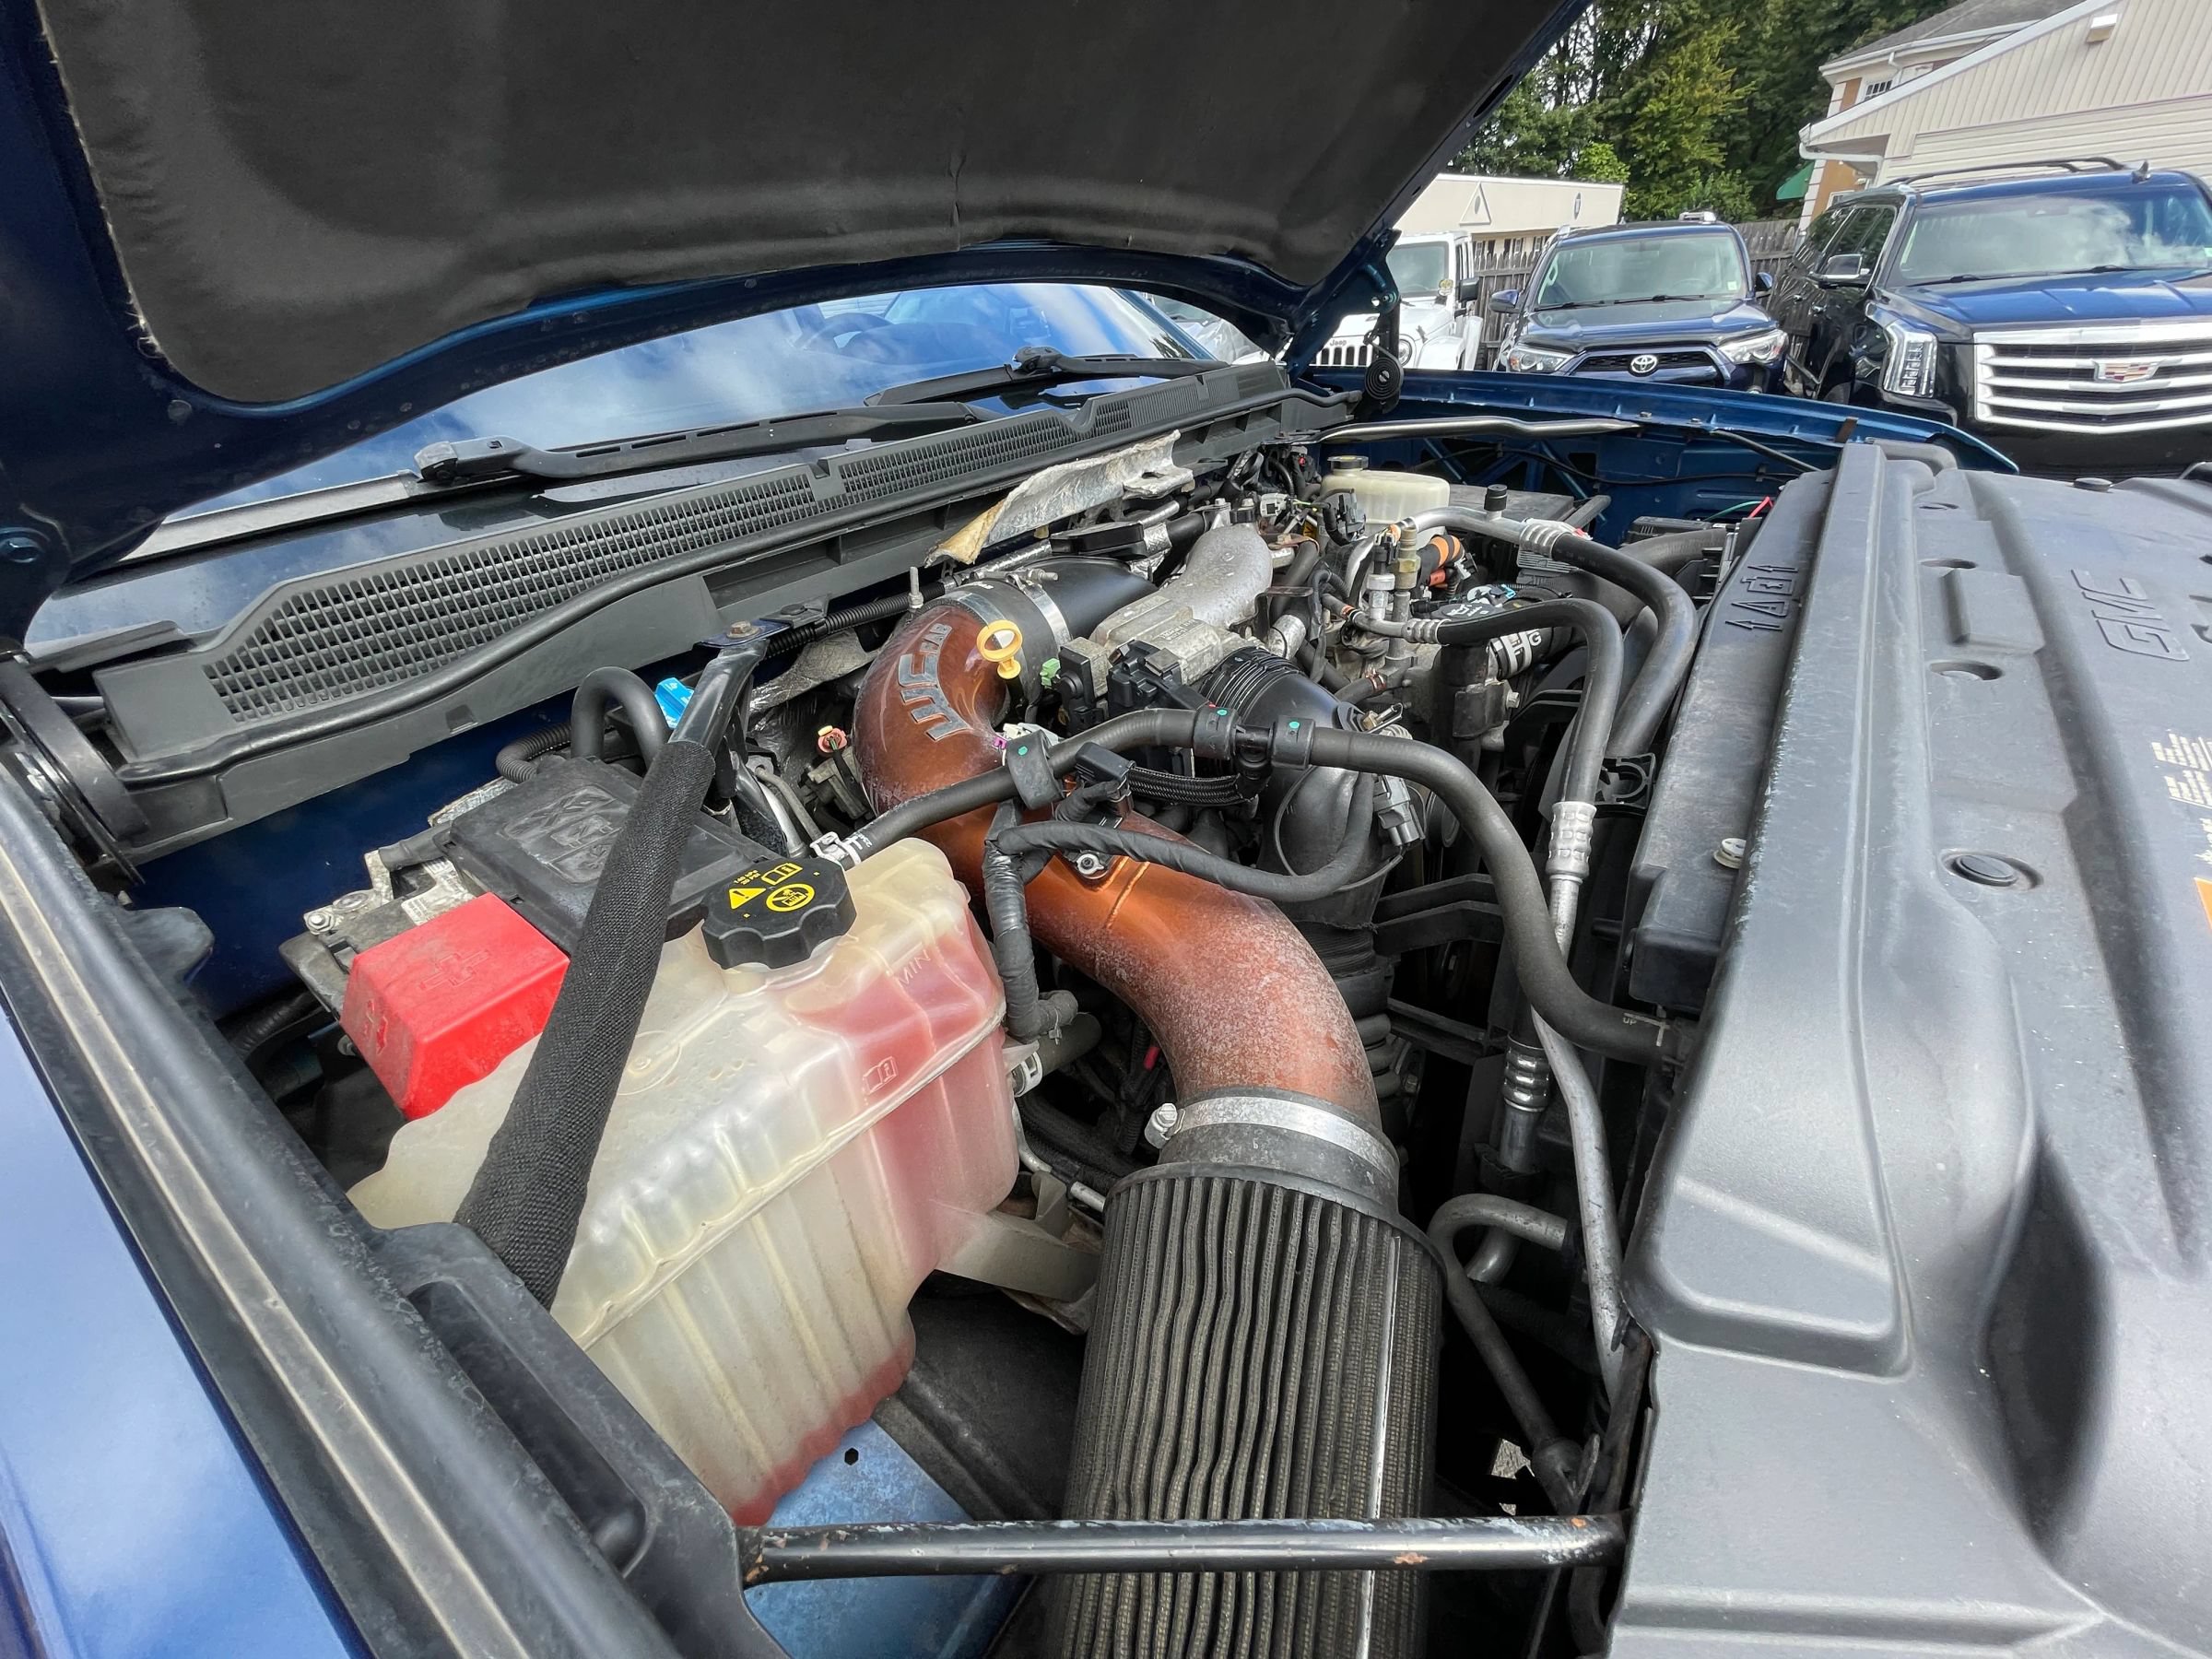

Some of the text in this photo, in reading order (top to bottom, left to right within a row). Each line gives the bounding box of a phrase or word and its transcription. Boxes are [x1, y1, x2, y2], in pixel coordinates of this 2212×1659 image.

[2070, 568, 2191, 662] GMC
[898, 947, 932, 985] MIN
[1622, 1017, 1637, 1026] UP
